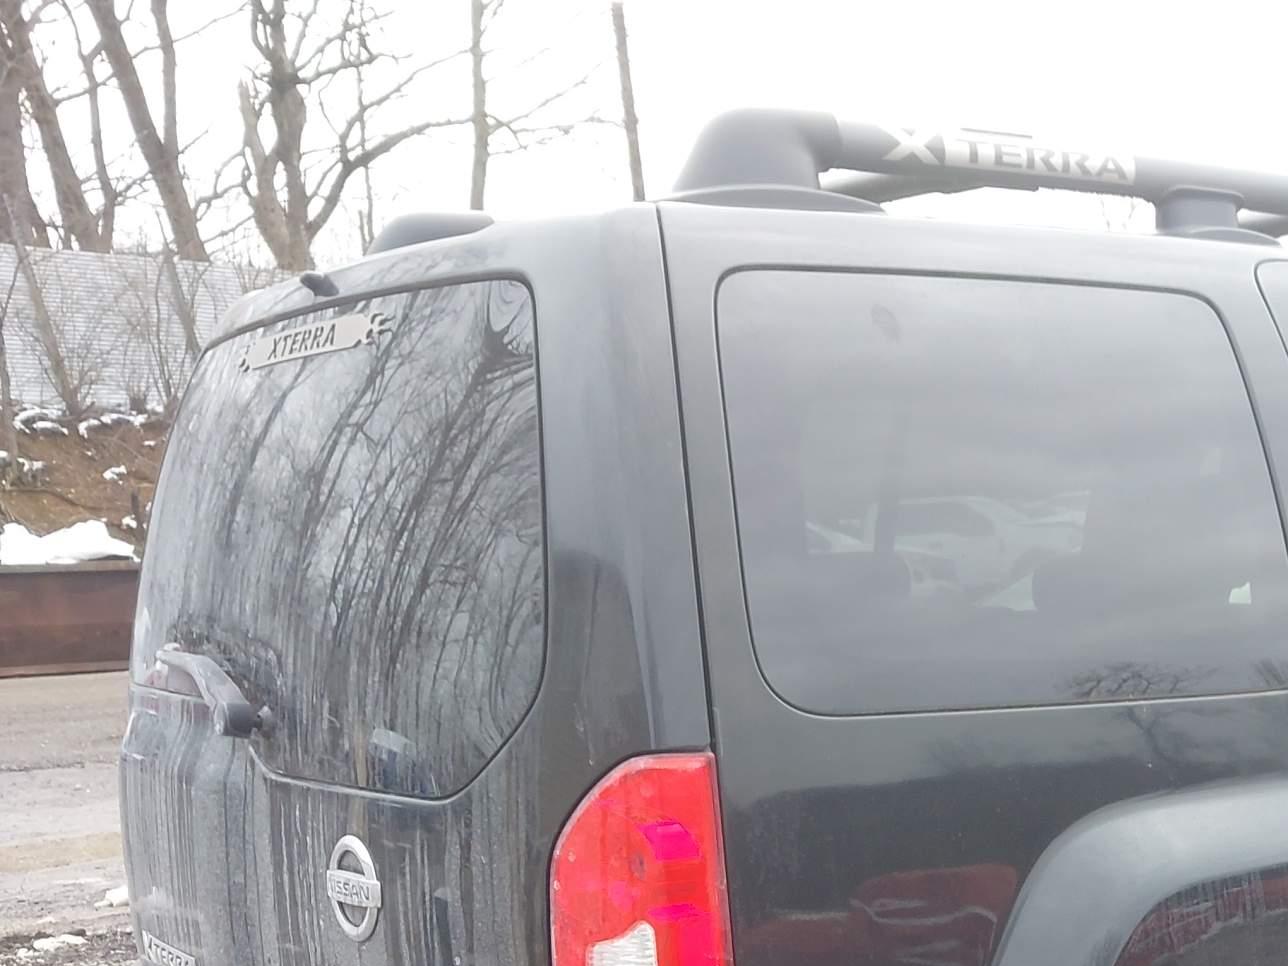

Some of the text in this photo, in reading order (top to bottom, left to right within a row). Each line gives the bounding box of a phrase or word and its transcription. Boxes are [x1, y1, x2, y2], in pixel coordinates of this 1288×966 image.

[880, 126, 1129, 182] XTERRA
[266, 322, 338, 361] XTERRA
[328, 876, 371, 902] NISSAN
